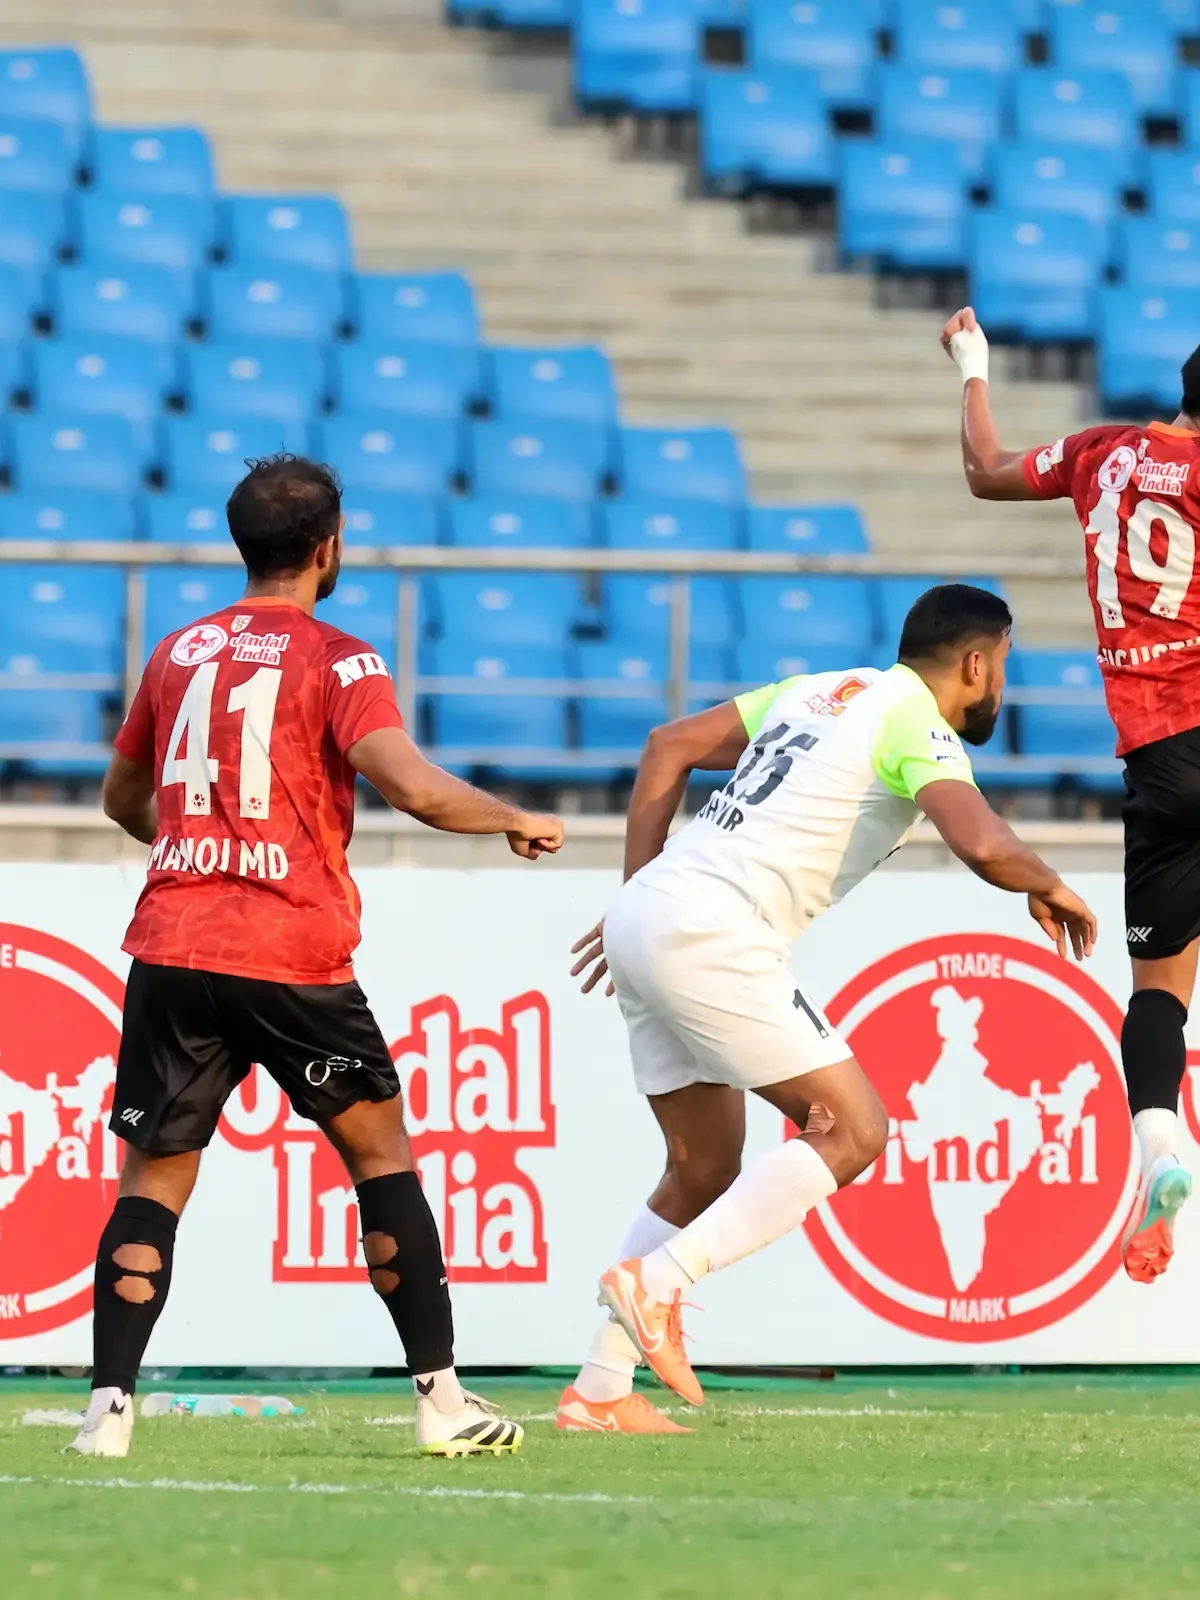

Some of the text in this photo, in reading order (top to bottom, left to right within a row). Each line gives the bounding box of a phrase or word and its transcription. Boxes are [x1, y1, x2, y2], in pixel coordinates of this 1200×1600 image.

[1139, 458, 1188, 480] Jindal
[1141, 475, 1180, 494] India
[1084, 491, 1196, 629] 19
[231, 633, 289, 650] Jindal
[235, 645, 279, 663] India
[161, 661, 284, 820] 41
[147, 834, 289, 880] MANOJ MD
[938, 952, 1003, 979] TRADE
[850, 1115, 1099, 1185] indal
[949, 1296, 1006, 1324] MARK
